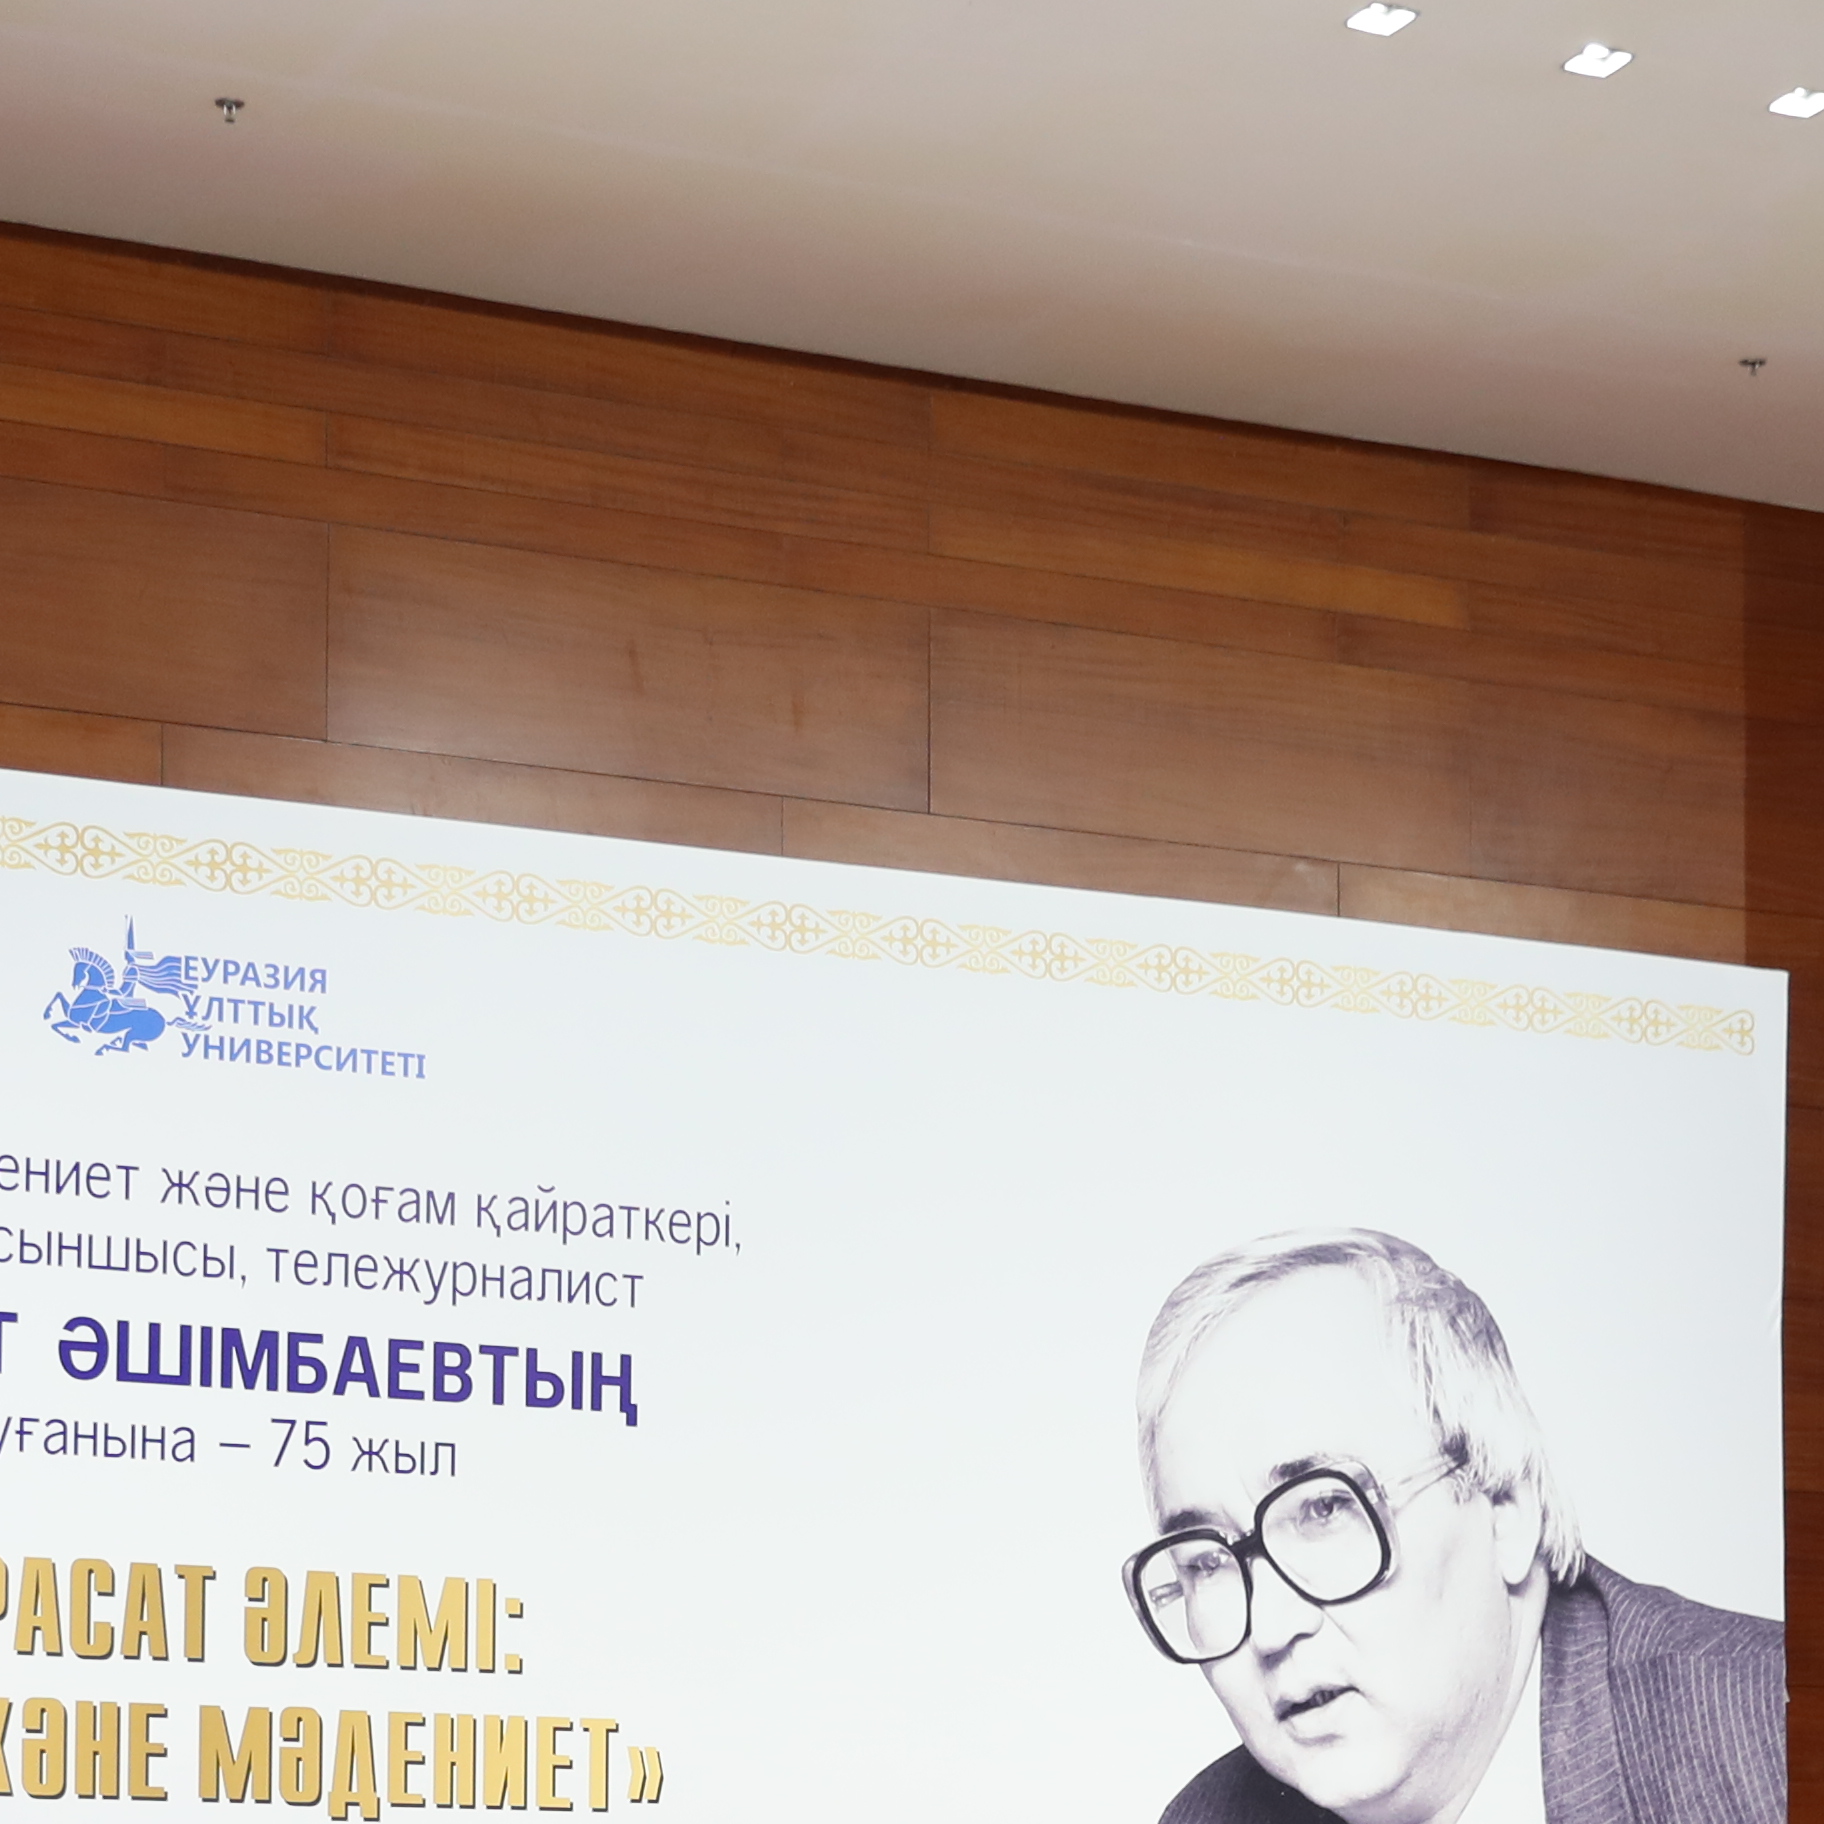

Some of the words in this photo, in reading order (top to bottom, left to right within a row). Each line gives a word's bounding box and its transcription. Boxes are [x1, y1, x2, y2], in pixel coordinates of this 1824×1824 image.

[185, 956, 326, 993] ЕУРАЗИЯ
[182, 994, 318, 1034] ҰЛТТЫҚ
[182, 1031, 425, 1078] УНИВЕРСИТЕТІ
[161, 1168, 289, 1213] және
[312, 1181, 455, 1225] қоғам
[477, 1185, 740, 1255] қайраткері,
[266, 1248, 644, 1308] тележурналист
[58, 1316, 638, 1427] ӘШІМБАЕВТЫҢ
[271, 1418, 330, 1470] 75
[351, 1437, 455, 1477] жыл
[244, 1567, 523, 1675] ӘЛЕМІ:
[199, 1704, 664, 1822] МӘДЕНИЕТ»
